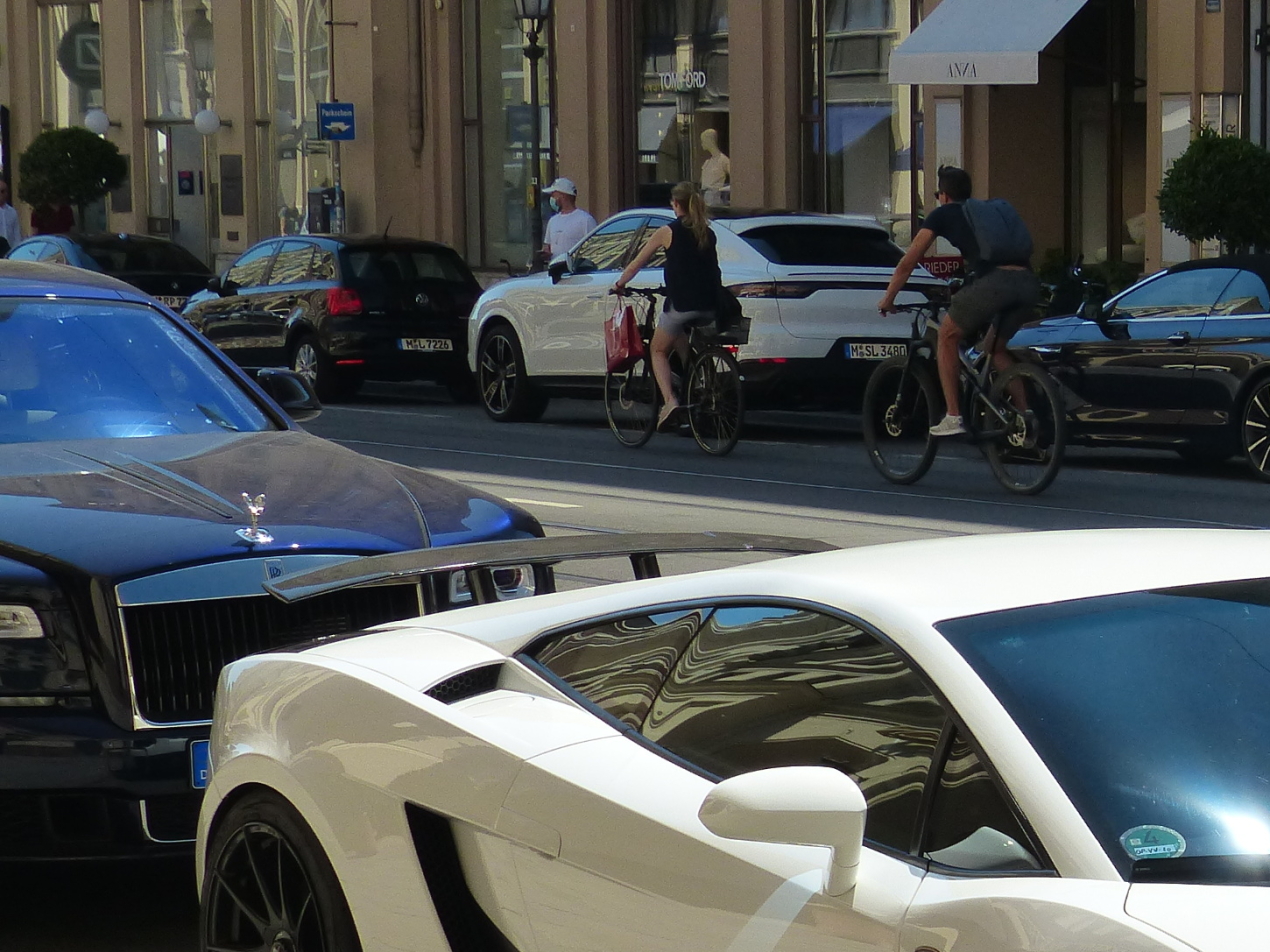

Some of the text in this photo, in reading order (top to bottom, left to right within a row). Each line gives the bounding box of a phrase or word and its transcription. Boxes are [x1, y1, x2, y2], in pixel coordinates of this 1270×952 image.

[947, 62, 980, 78] ANZA
[659, 72, 678, 91] TOM
[1144, 829, 1160, 844] 4
